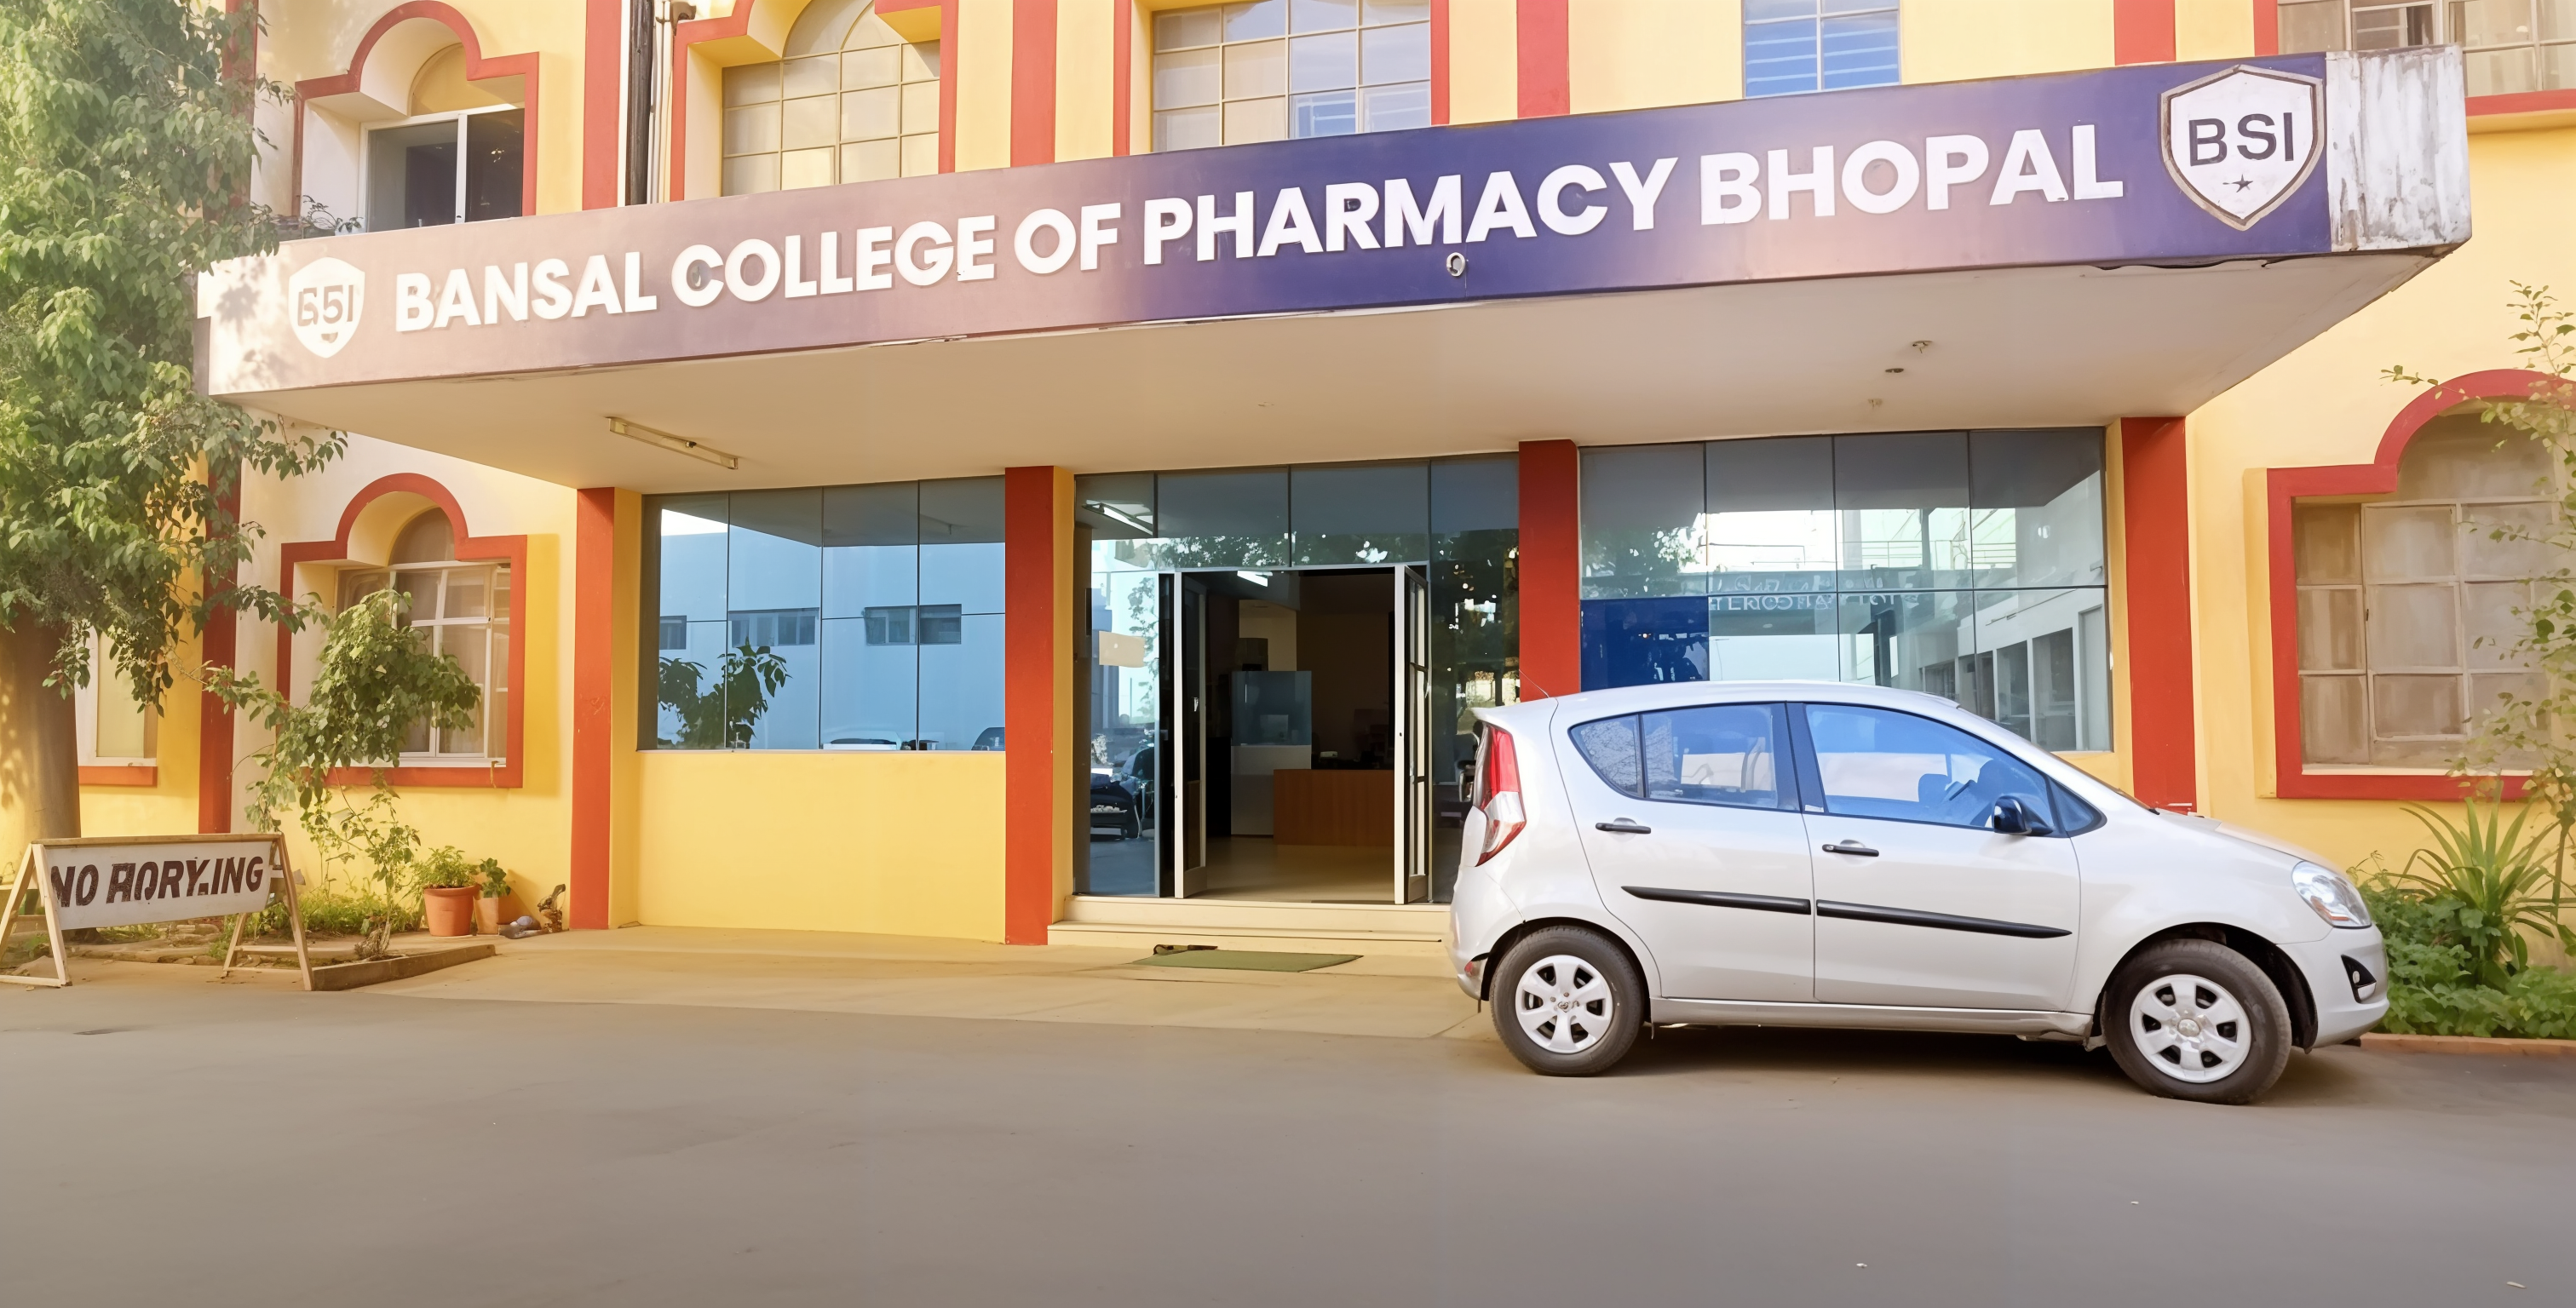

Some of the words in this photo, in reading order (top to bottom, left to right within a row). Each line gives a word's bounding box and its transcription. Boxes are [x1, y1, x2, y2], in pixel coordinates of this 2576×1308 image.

[2188, 112, 2295, 167] BSI
[395, 251, 658, 333] BANSAL
[670, 215, 997, 307] COLLEGE
[1014, 202, 1121, 275] OF
[1143, 157, 1678, 266] PHARMACY
[1699, 123, 2124, 226] BHOPAL
[50, 863, 100, 908] NO
